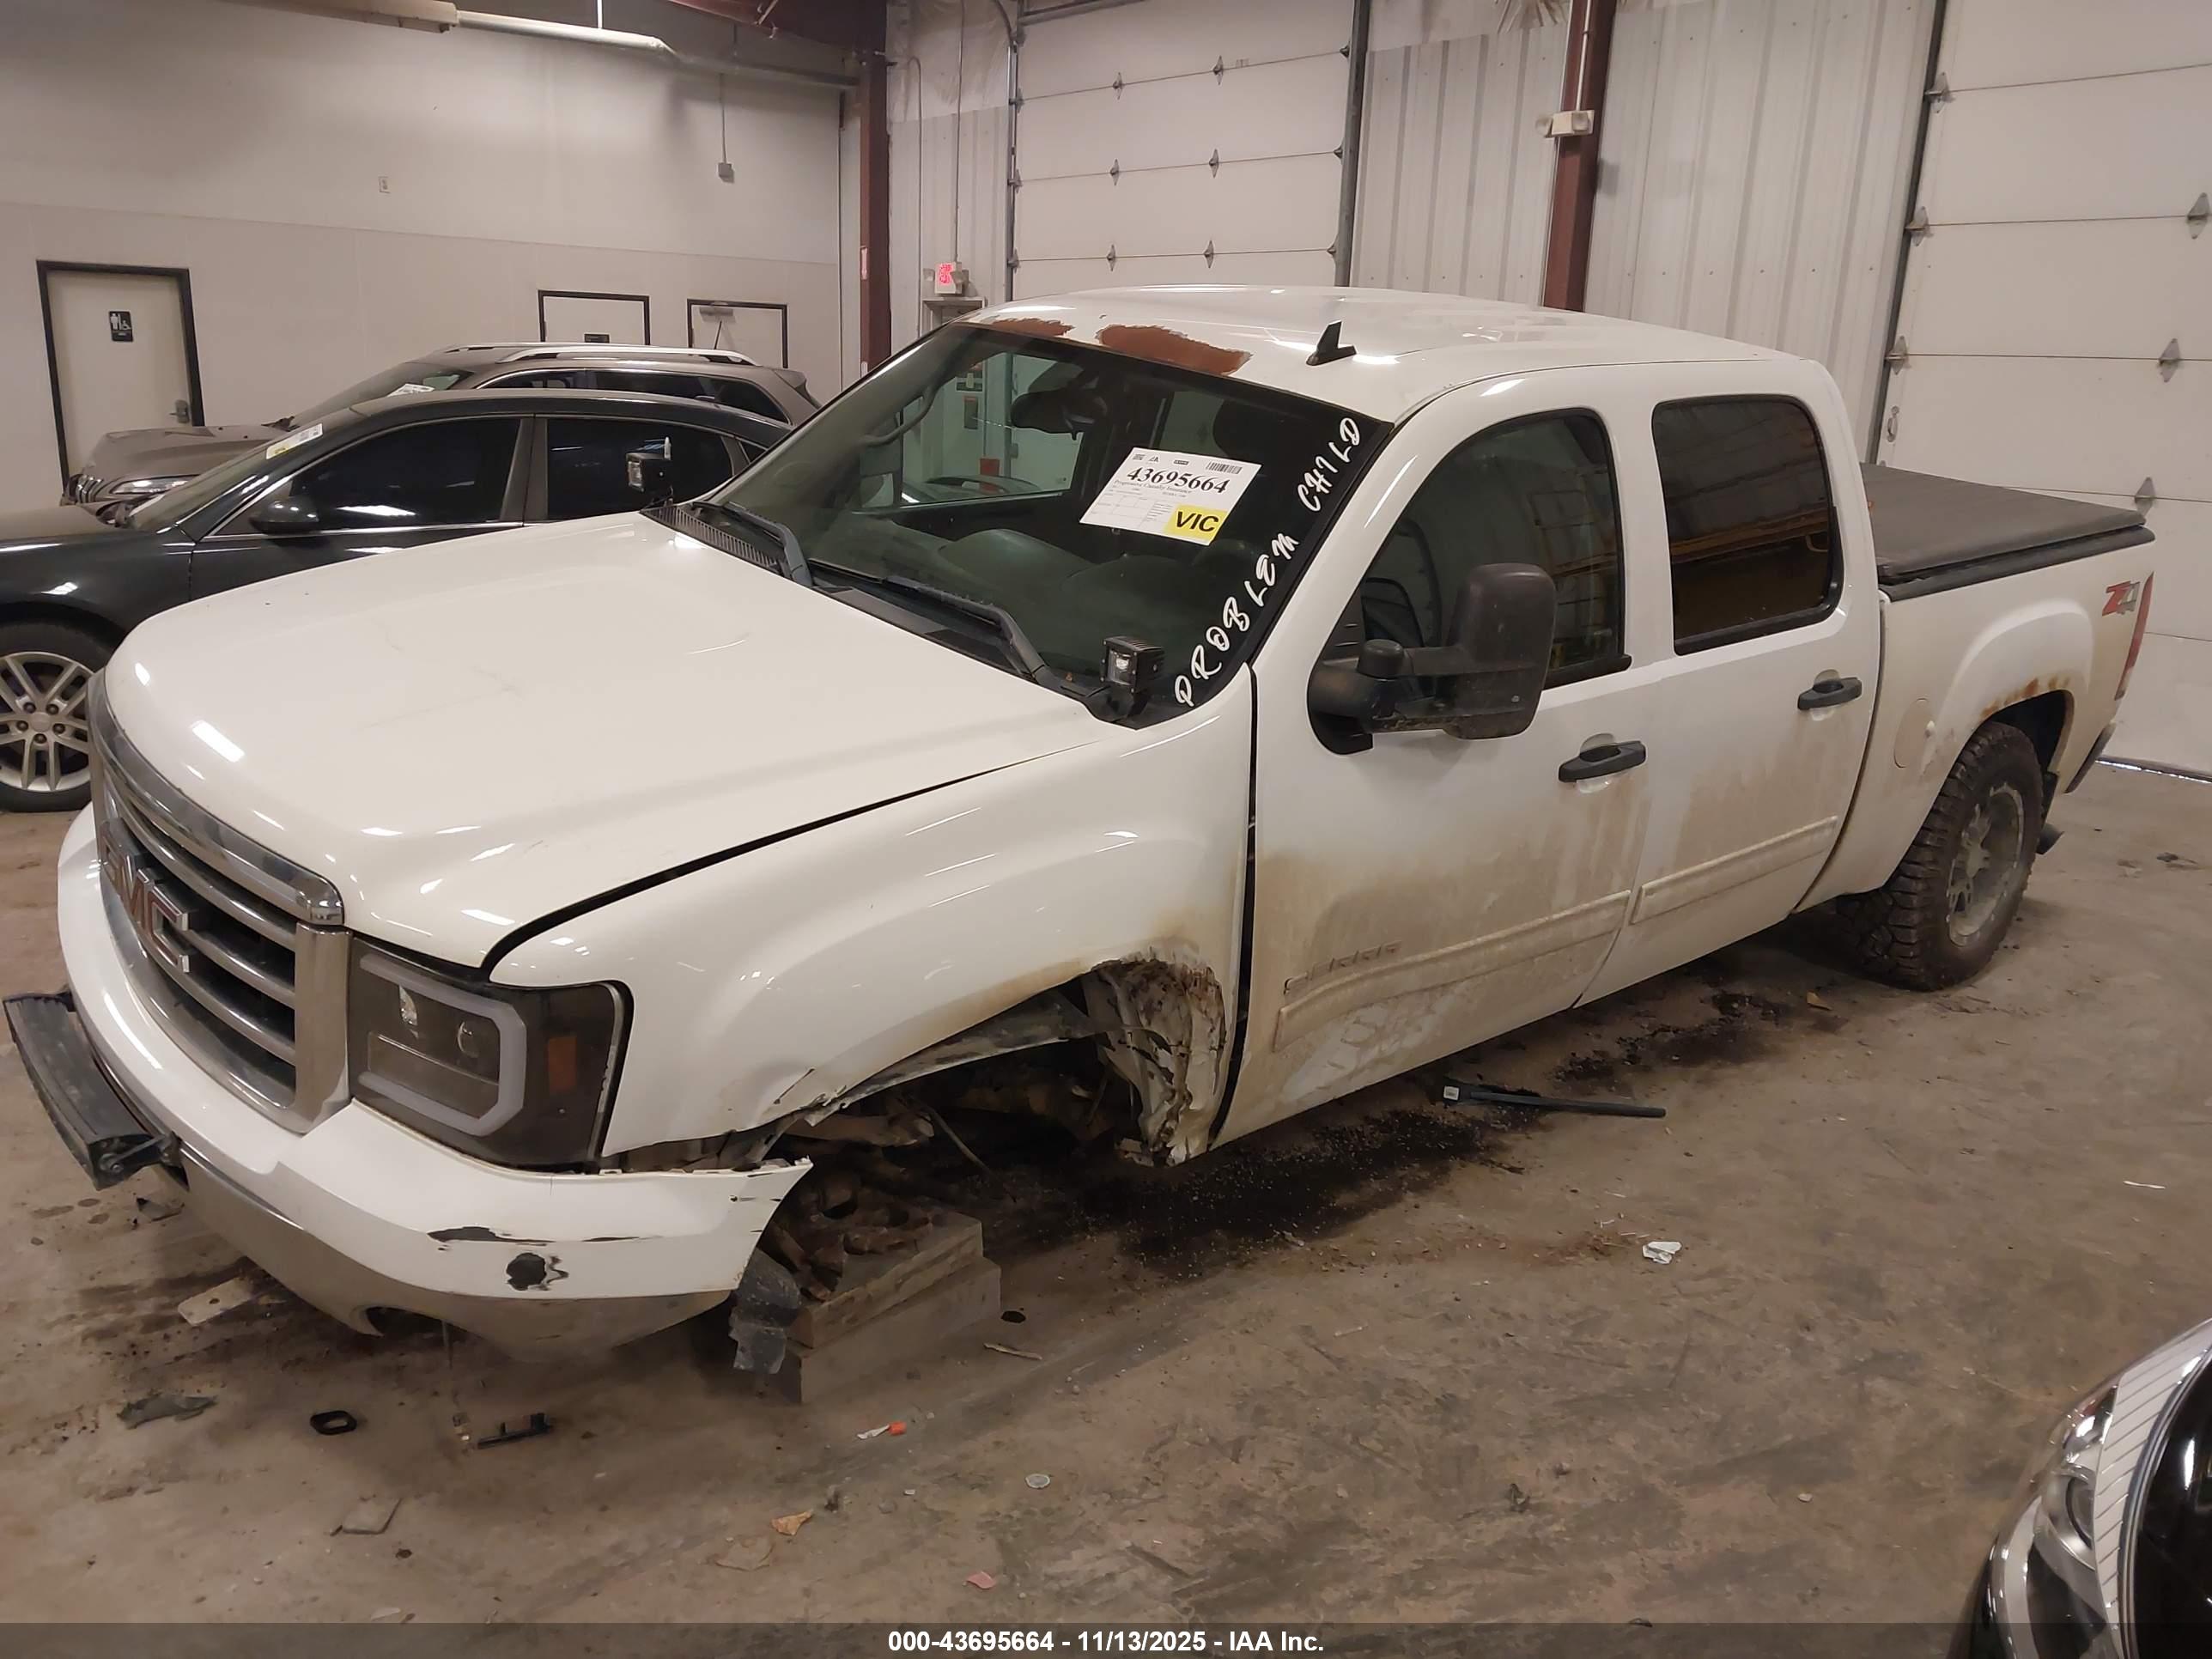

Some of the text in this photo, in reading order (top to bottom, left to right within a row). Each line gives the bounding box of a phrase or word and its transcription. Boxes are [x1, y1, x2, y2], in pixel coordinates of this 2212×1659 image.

[1127, 467, 1230, 493] 43695664
[1176, 511, 1219, 532] VIC
[1174, 417, 1360, 707] PROBLEM CHILD
